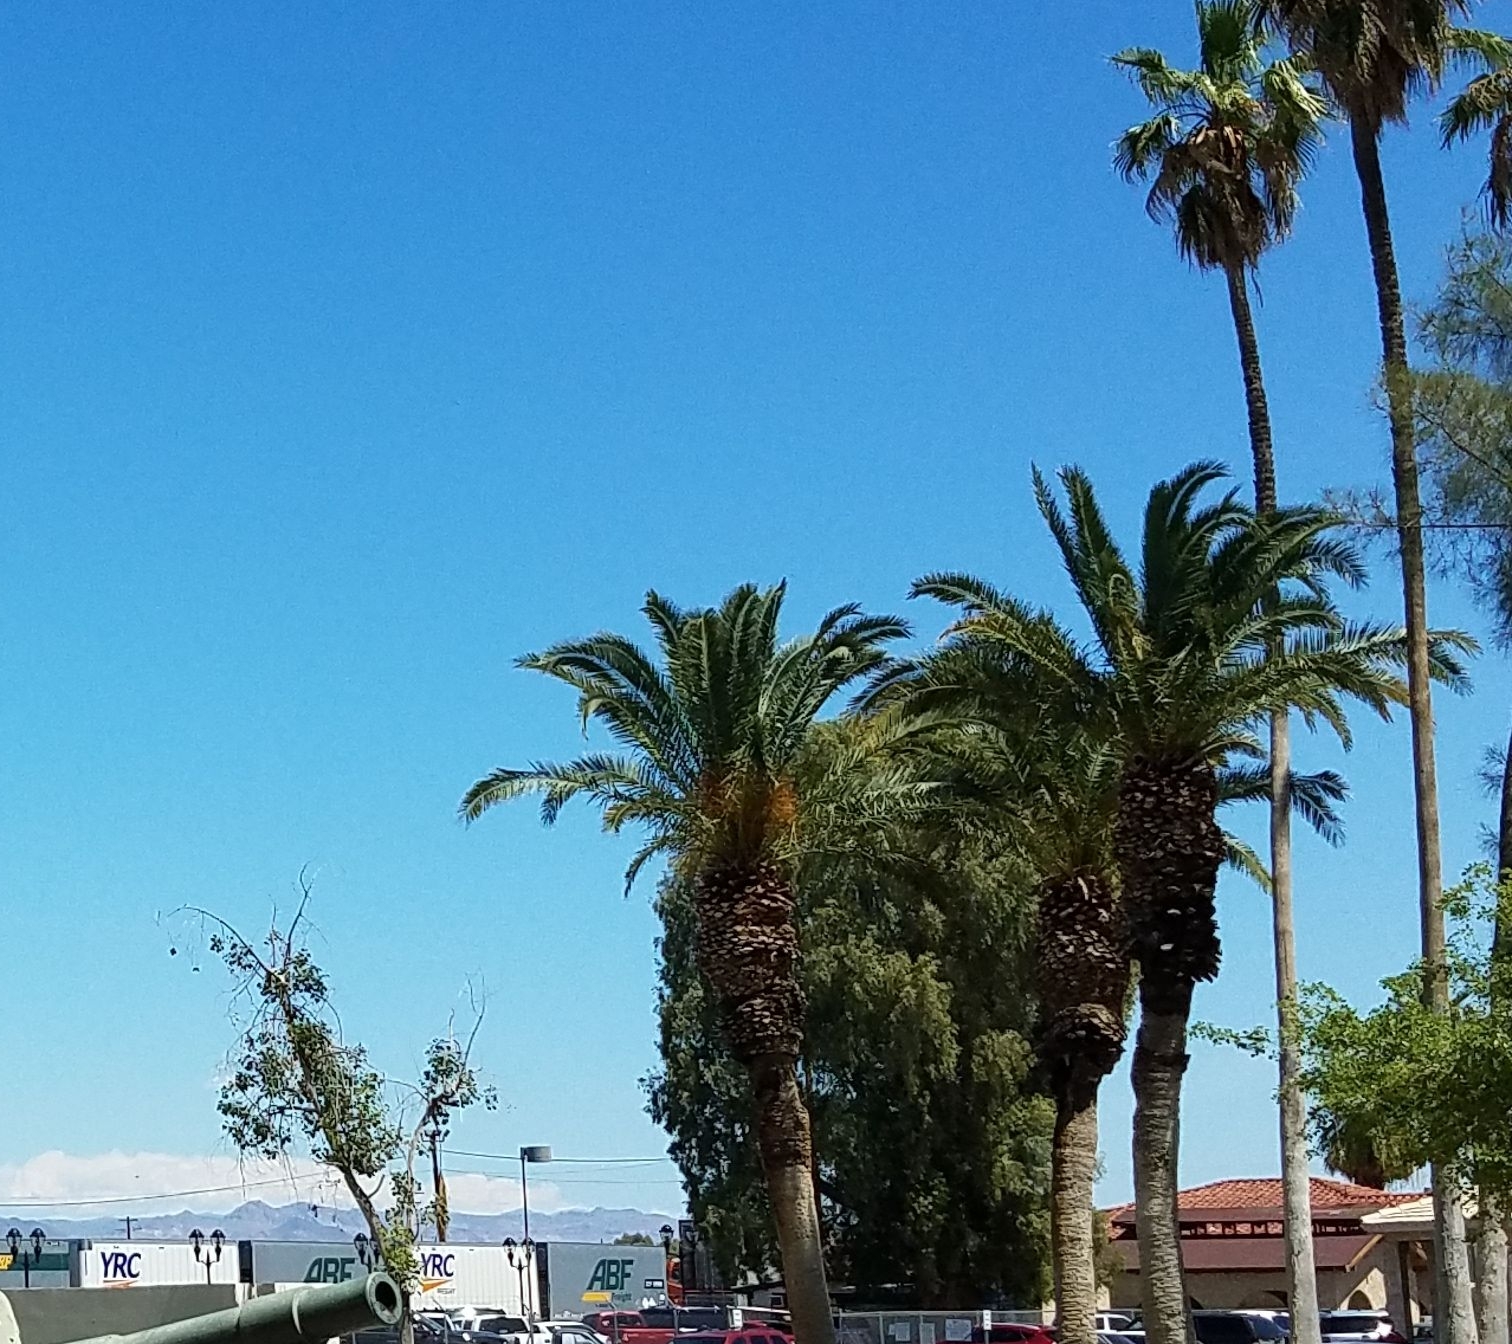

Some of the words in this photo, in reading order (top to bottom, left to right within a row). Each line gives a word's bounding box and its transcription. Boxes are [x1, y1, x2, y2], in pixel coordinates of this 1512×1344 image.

[100, 1252, 141, 1278] YRC
[303, 1257, 356, 1283] ABF
[420, 1253, 455, 1277] YRC
[586, 1258, 634, 1290] ABF
